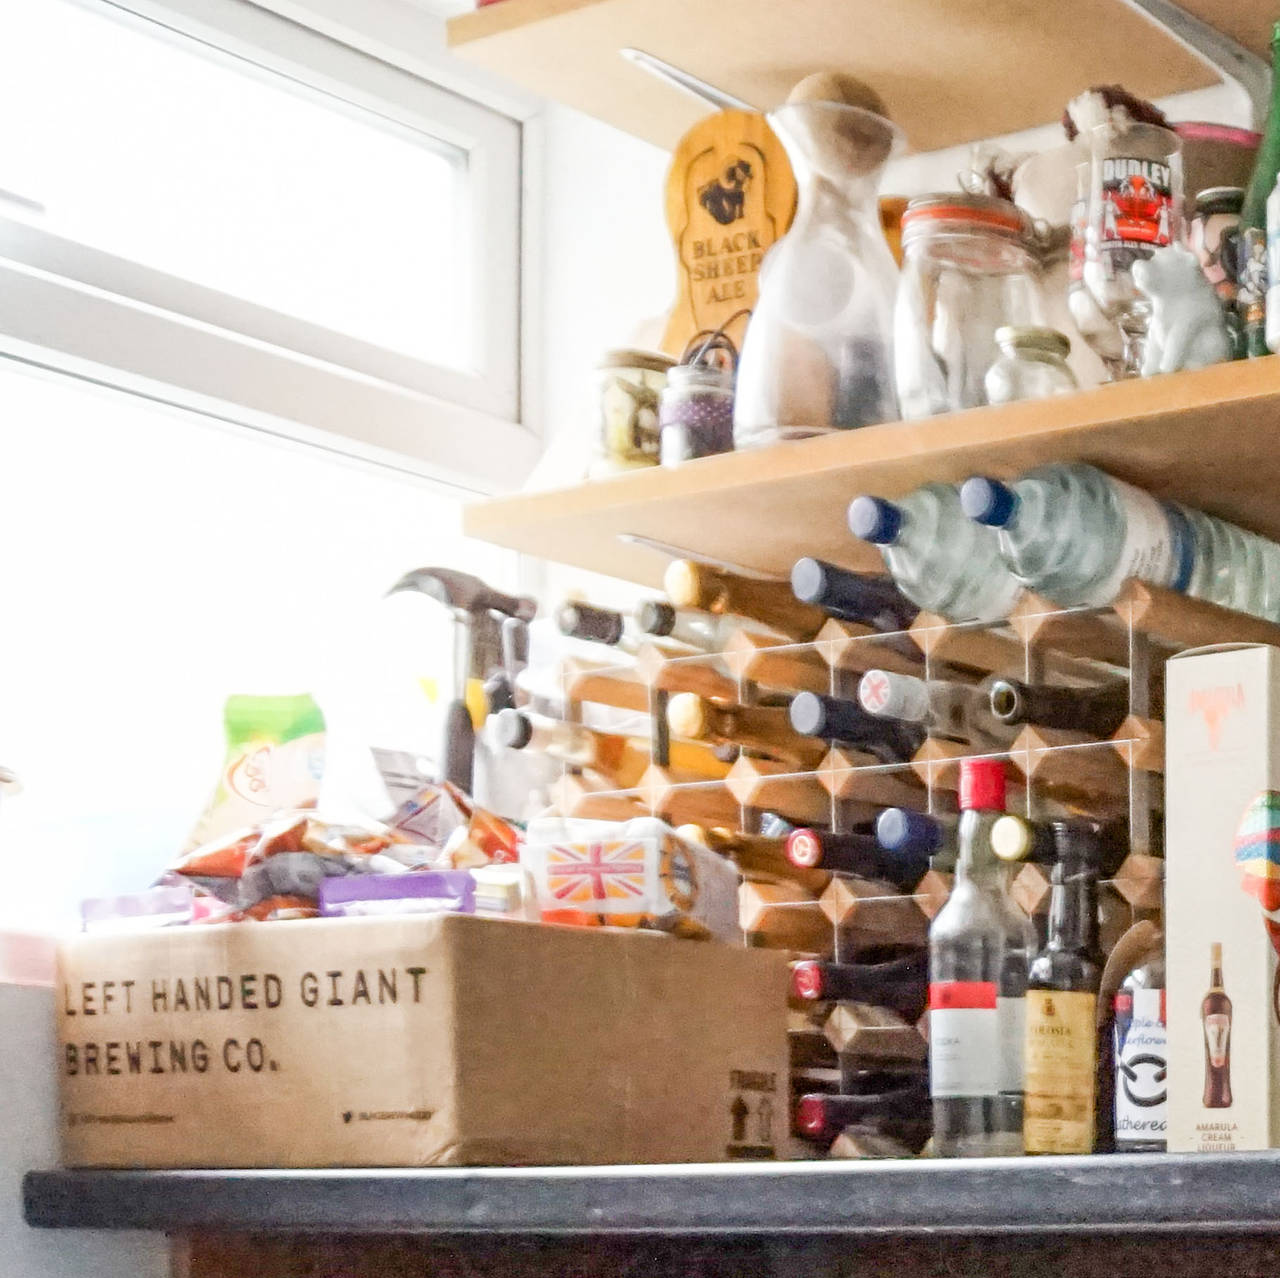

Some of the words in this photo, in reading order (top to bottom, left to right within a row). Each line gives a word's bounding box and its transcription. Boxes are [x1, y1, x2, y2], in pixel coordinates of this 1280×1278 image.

[1103, 159, 1170, 188] DUDLEY
[693, 230, 761, 259] BLACK
[706, 280, 746, 304] ALE
[65, 979, 136, 1016] LEFT
[152, 973, 283, 1013] HANDED
[300, 966, 427, 1008] GIANT
[65, 1037, 210, 1076] BREWING
[223, 1036, 280, 1074] CO.
[1195, 1122, 1239, 1132] AMARULA
[1201, 1134, 1232, 1143] CREAM
